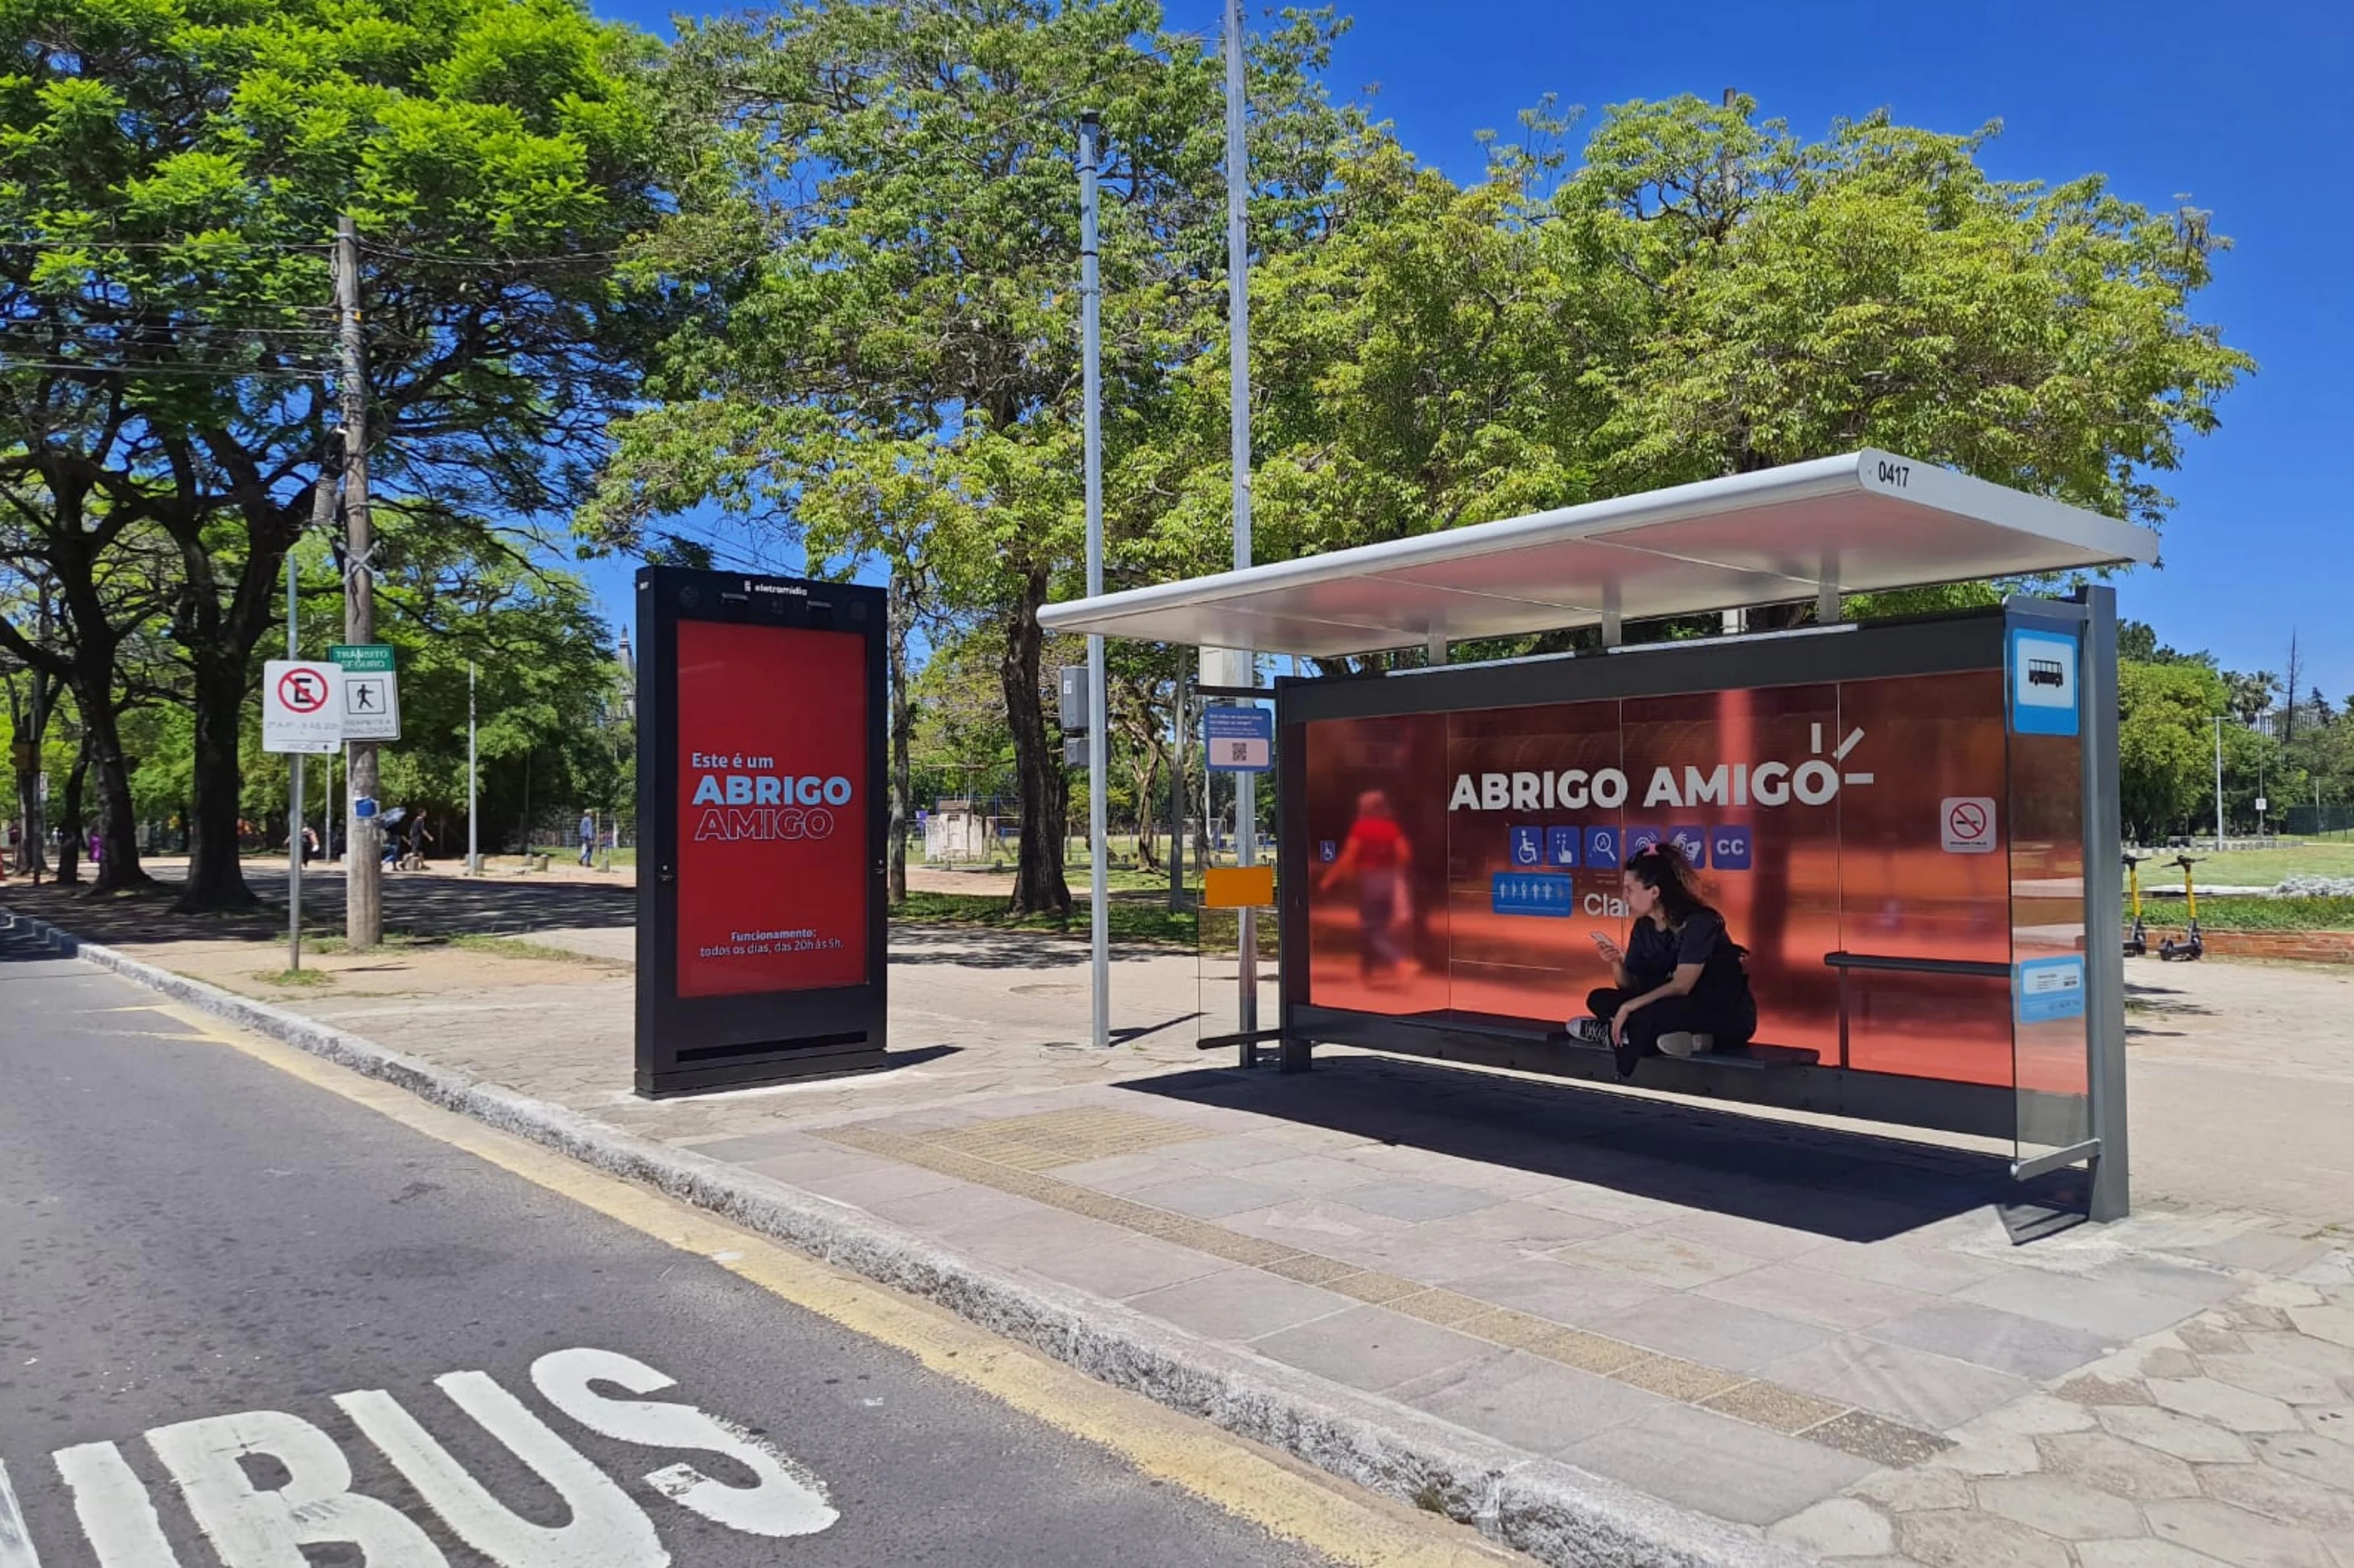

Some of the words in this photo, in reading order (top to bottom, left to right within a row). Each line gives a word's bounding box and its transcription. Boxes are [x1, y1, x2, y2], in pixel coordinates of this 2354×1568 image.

[1879, 460, 1910, 488] 0417
[294, 678, 312, 703] E
[692, 752, 728, 769] Este
[733, 753, 742, 769] é
[747, 756, 773, 769] um
[692, 774, 852, 805] ABRIGO
[1447, 767, 1628, 812] ABRIGO
[1643, 759, 1839, 807] AMIGO
[694, 807, 834, 841] AMIGO
[1717, 839, 1744, 856] CC
[731, 929, 817, 942] Funcionamento:
[701, 944, 731, 957] todos
[774, 942, 792, 952] das
[794, 940, 814, 951] 20h
